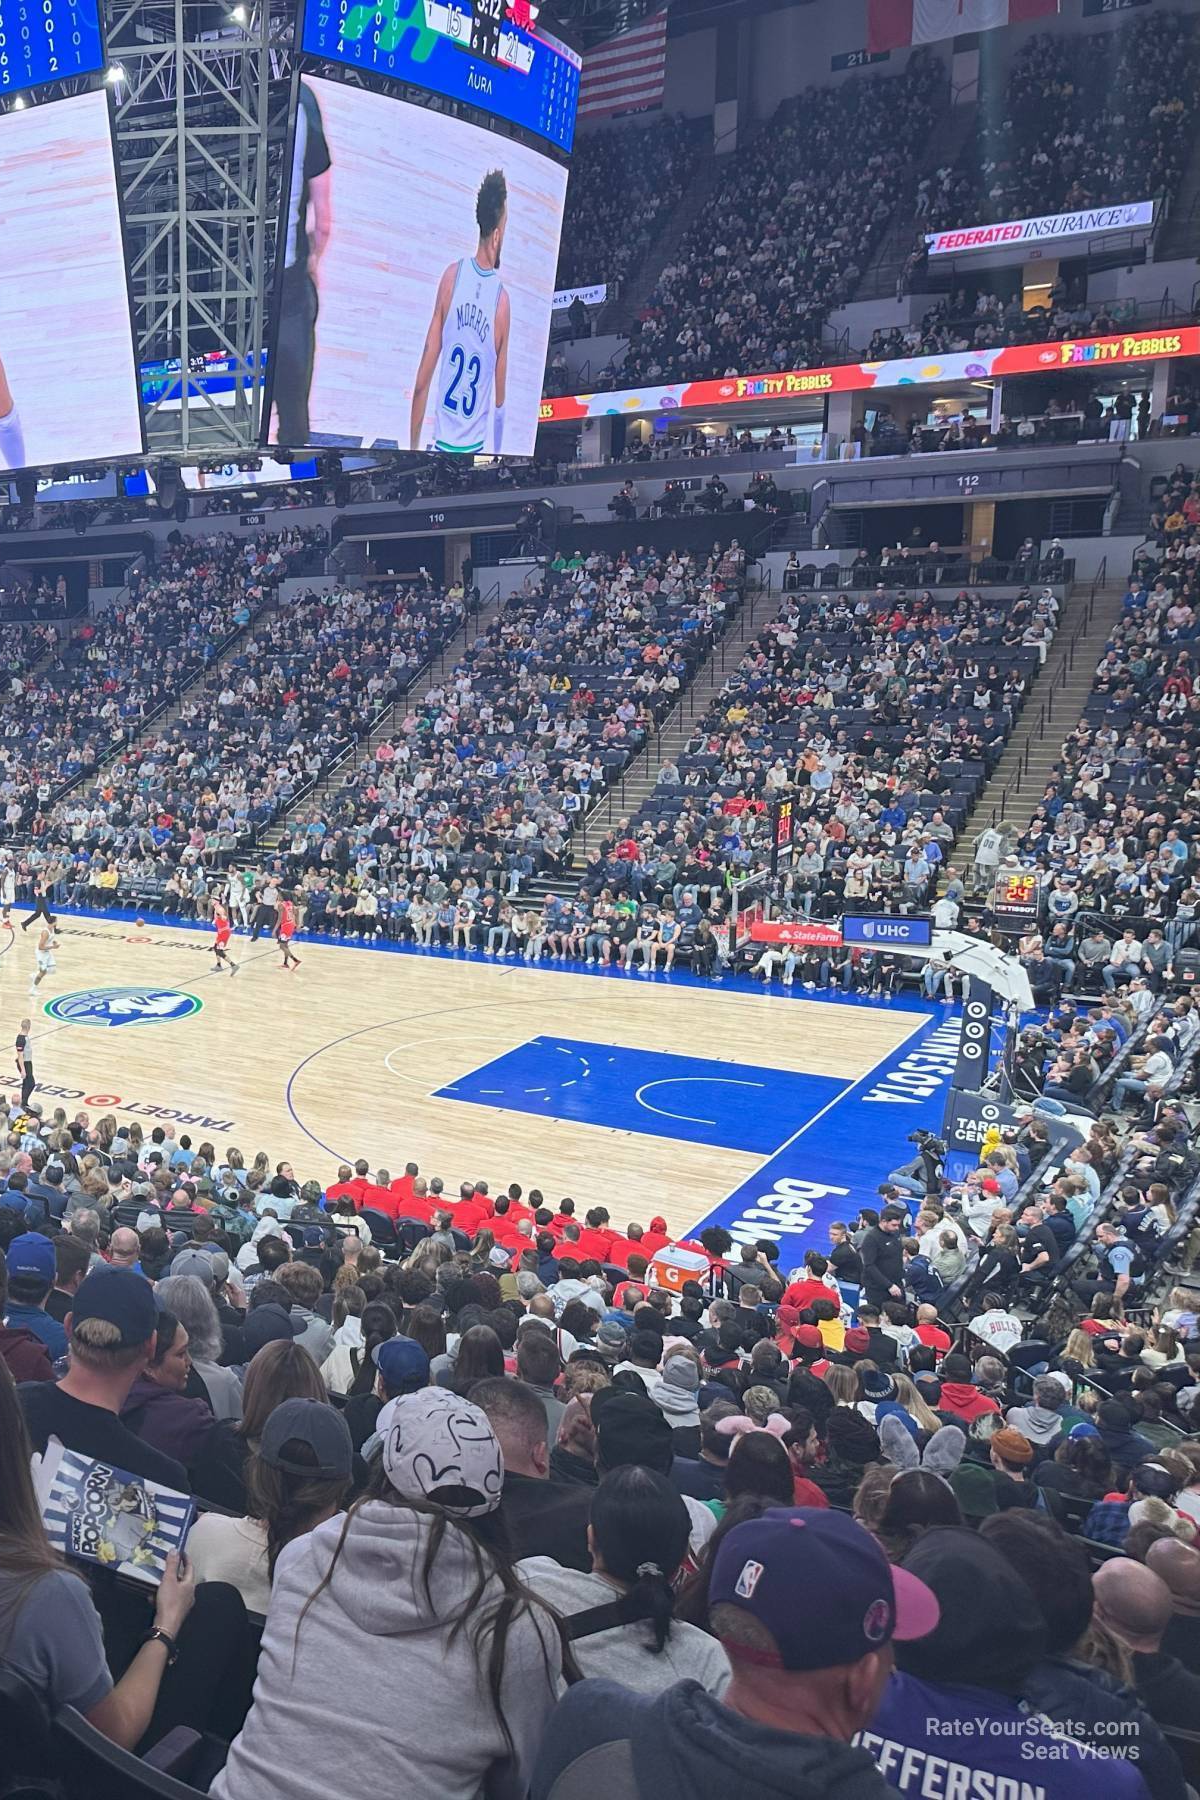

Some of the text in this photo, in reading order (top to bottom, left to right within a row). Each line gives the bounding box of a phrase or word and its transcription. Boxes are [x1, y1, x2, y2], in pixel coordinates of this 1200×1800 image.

[20, 7, 27, 21] 3
[43, 0, 51, 14] 0
[340, 0, 382, 25] 0 0
[447, 3, 461, 37] 15
[21, 26, 29, 39] 0
[46, 20, 54, 33] 0
[339, 20, 380, 44] 2 0
[0, 52, 8, 65] 6
[24, 45, 31, 59] 3
[49, 39, 53, 52] 1
[73, 32, 81, 45] 0
[337, 40, 395, 68] 4 1 0
[472, 35, 496, 57] 6 1 6
[505, 32, 518, 64] 21
[847, 51, 871, 66] 211
[3, 71, 10, 84] 5
[50, 58, 58, 71] 2
[936, 209, 1122, 250] FEDERATED INSURANCE
[456, 303, 490, 343] MORRIS
[1060, 334, 1180, 363] FRUITY PEBBLES
[190, 357, 203, 366] 3:12
[443, 343, 481, 419] 23
[736, 373, 833, 397] FRUITY PEBBLES
[956, 475, 979, 487] 112
[245, 516, 259, 525] 109
[429, 514, 445, 523] 110
[778, 817, 791, 844] 24
[983, 840, 995, 849] 00
[1007, 887, 1028, 900] 24
[877, 924, 910, 937] UHC
[116, 1102, 236, 1132] TARGET
[666, 1270, 679, 1283] G
[990, 1320, 1018, 1334] BULLS
[81, 1463, 114, 1558] POPCORN
[73, 1512, 83, 1553] CRUNCH
